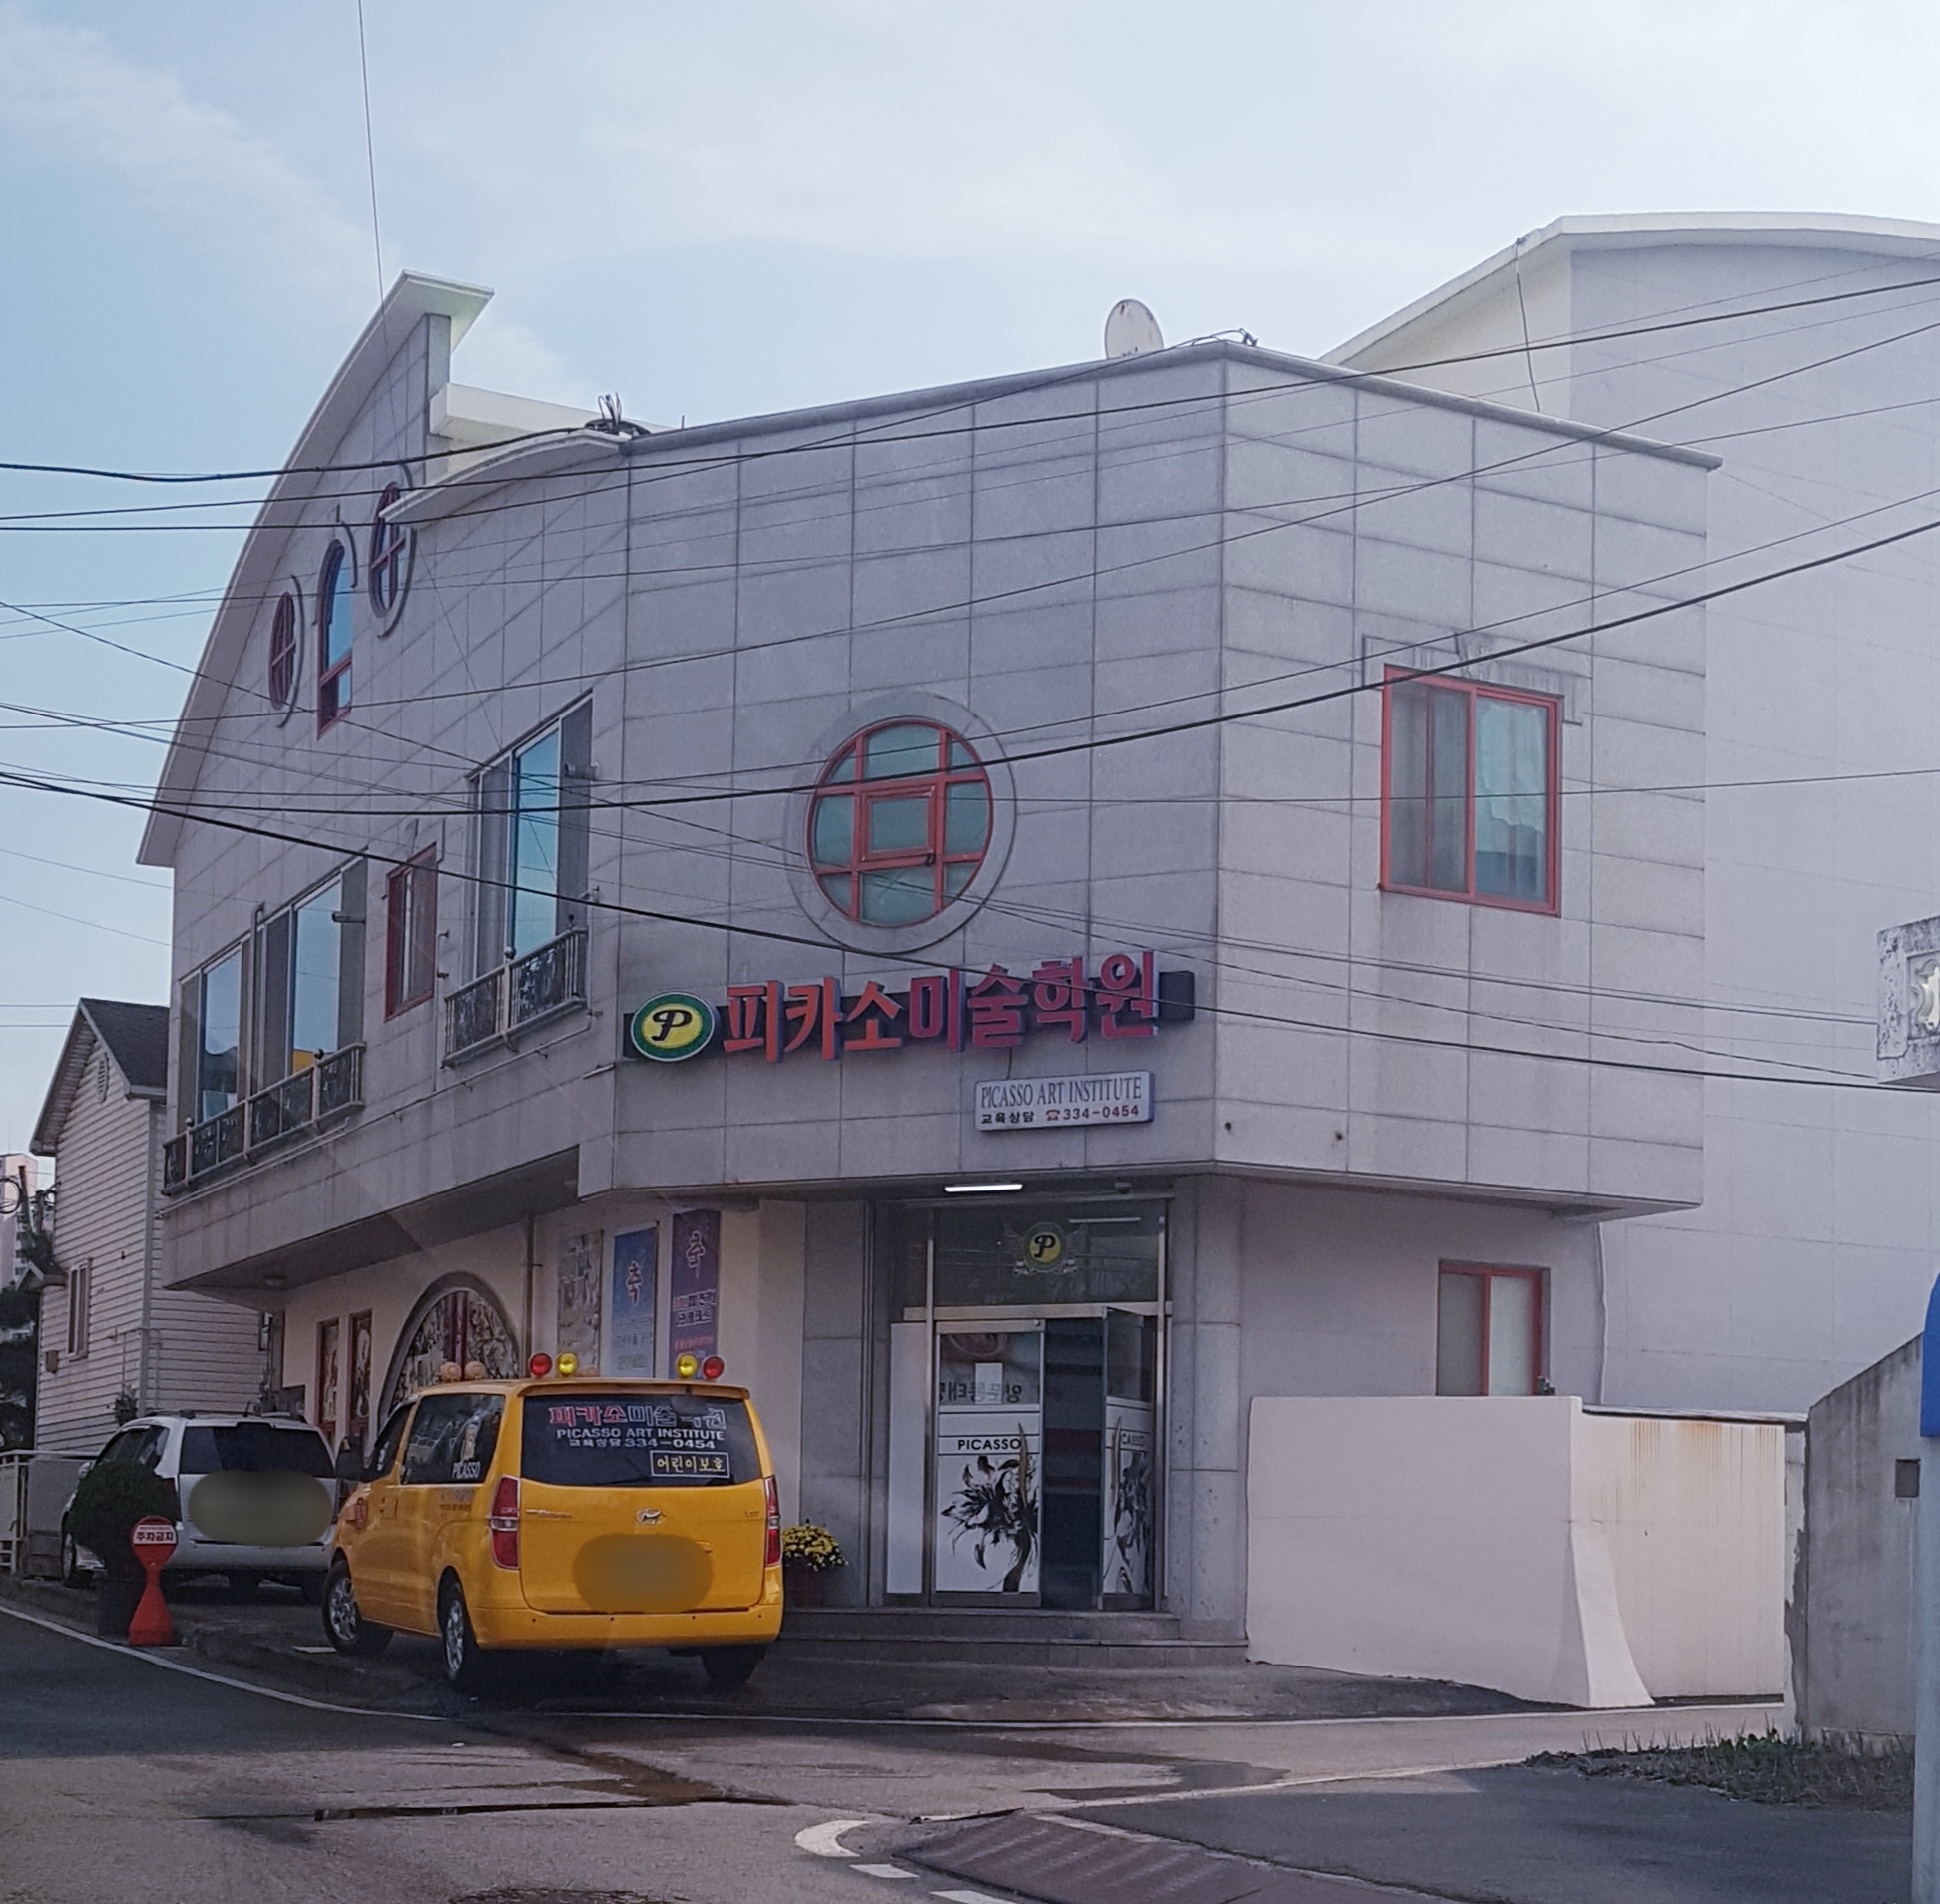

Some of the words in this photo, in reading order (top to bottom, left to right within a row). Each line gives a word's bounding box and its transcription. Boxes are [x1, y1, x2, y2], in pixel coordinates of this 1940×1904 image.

[723, 951, 1159, 1063] 피카소미술학원
[981, 1083, 1034, 1109] PICASSO
[1037, 1082, 1066, 1105] ART
[1069, 1077, 1142, 1103] INSTITUTE
[1063, 1105, 1140, 1121] 334-0454
[557, 1428, 621, 1439] PICASSO
[626, 1428, 653, 1438] ART
[658, 1428, 725, 1441] INSTITUTE
[625, 1438, 716, 1449] 334-0454
[957, 1438, 1022, 1450] PICASSO
[136, 1531, 174, 1542] 주차금지
